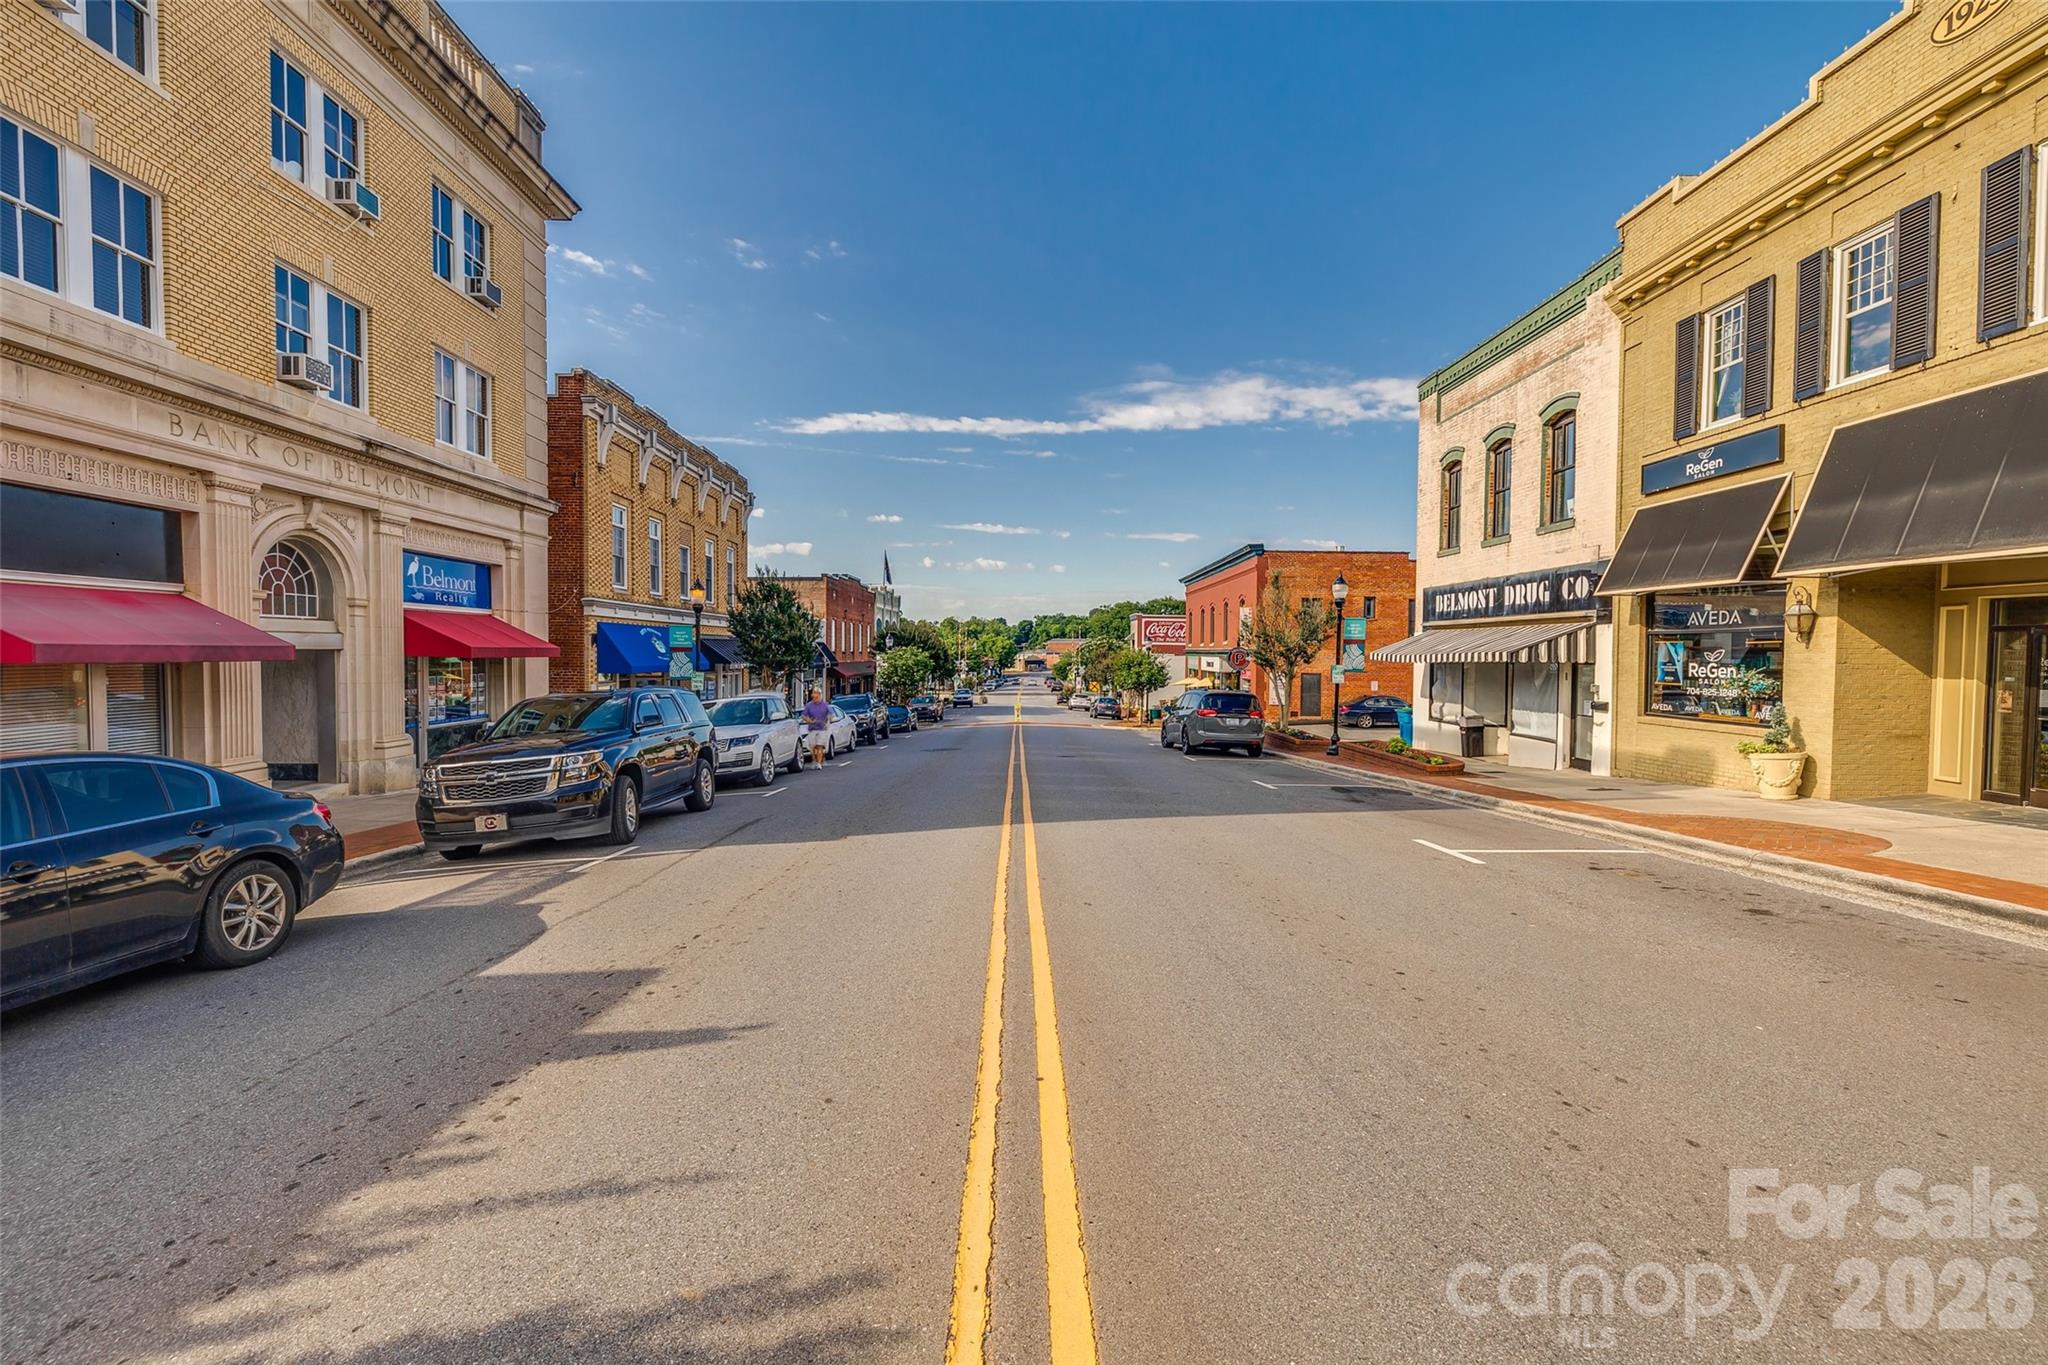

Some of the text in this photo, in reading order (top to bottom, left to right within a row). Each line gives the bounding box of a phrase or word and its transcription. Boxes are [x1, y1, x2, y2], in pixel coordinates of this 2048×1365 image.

[1943, 0, 1999, 38] 192
[168, 411, 434, 504] BANK OF BELMONT
[1685, 458, 1724, 476] ReGen
[1693, 469, 1716, 480] SALON
[422, 564, 477, 592] Belmont
[435, 592, 469, 605] Realty
[1435, 587, 1498, 613] BELMONT
[1504, 580, 1551, 606] DRUG
[1686, 609, 1743, 626] AVEDA
[1146, 622, 1186, 638] Coca-Col
[1688, 662, 1737, 678] ReGen
[1698, 678, 1727, 686] SALON
[1686, 687, 1739, 698] 704-825-1248
[1651, 703, 1673, 712] AVEDA
[1754, 712, 1771, 720] AVE
